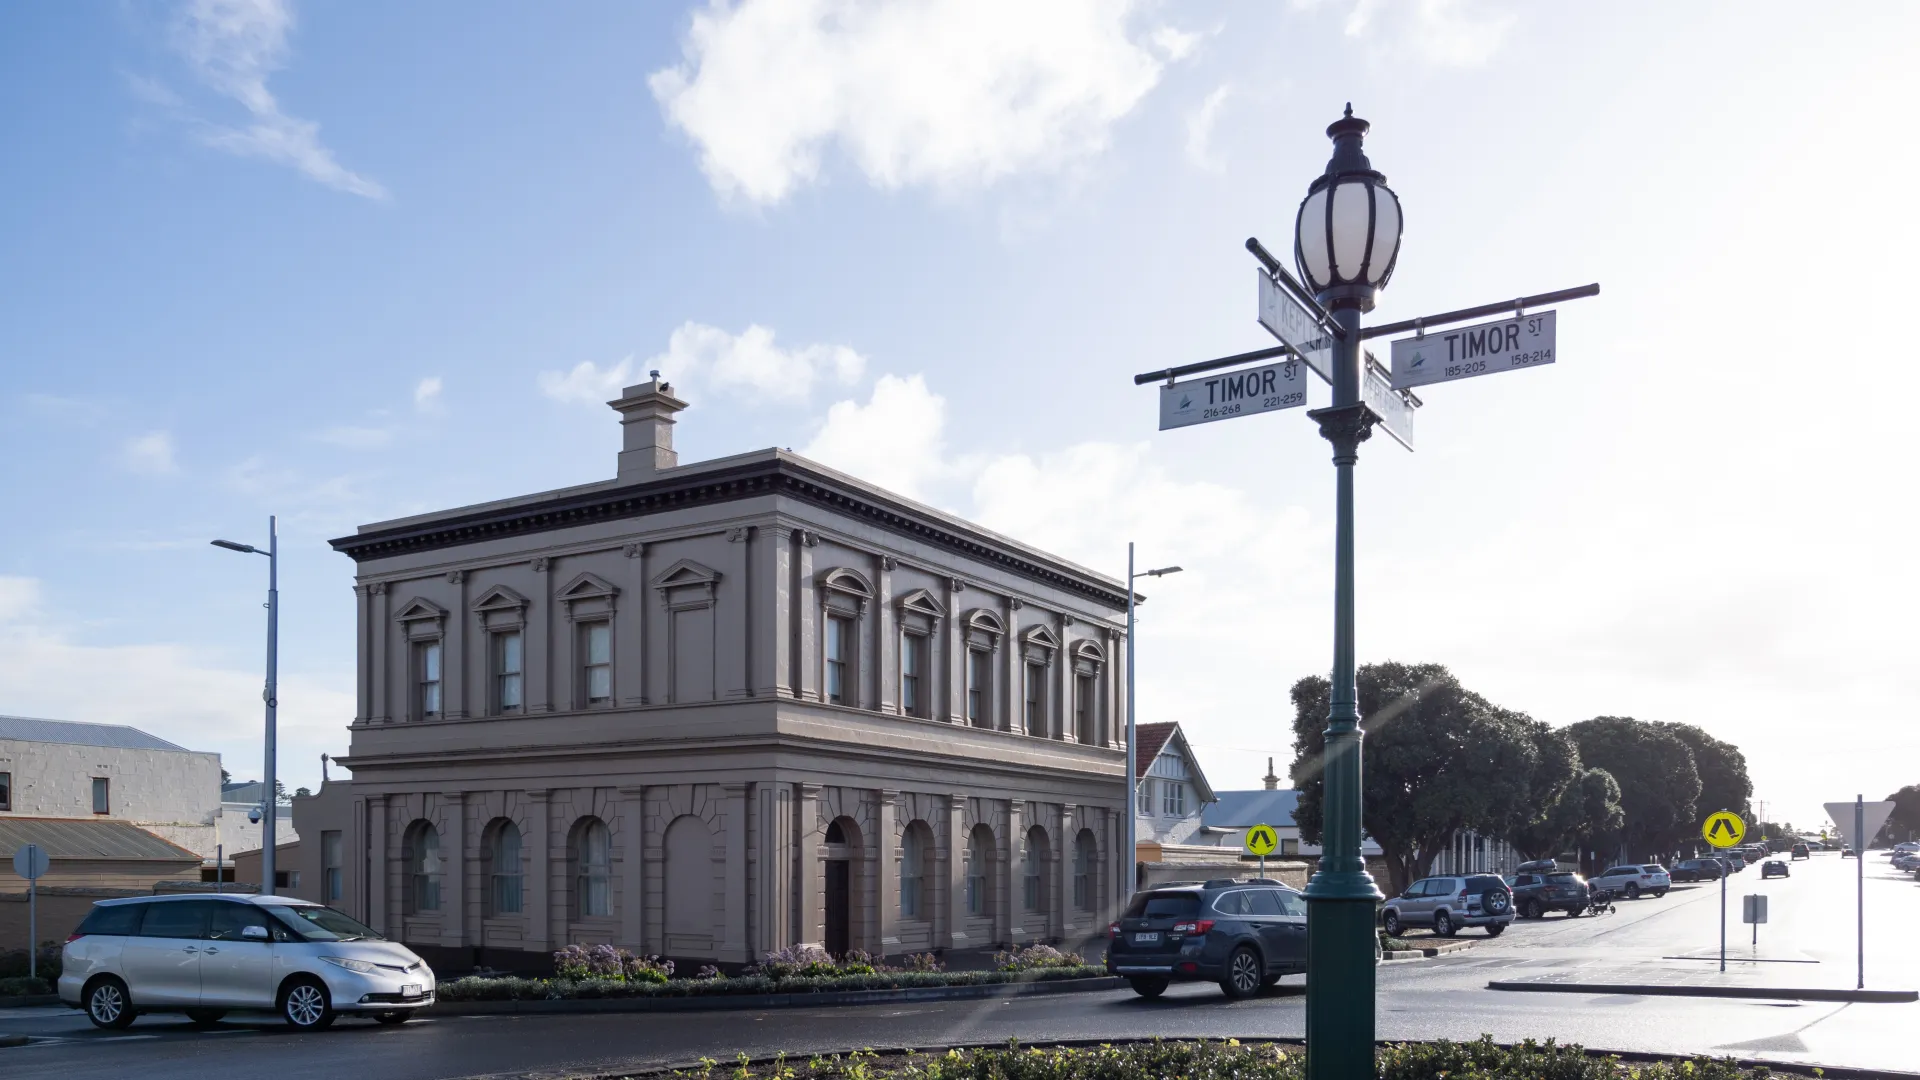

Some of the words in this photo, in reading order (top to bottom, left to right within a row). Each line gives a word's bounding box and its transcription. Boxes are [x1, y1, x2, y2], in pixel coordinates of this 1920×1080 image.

[1444, 323, 1520, 362] TIMOR
[1528, 318, 1544, 335] ST
[1444, 361, 1486, 377] 185-205
[1511, 349, 1551, 366] 158-214
[1205, 369, 1276, 405] TIMOR
[1284, 363, 1298, 379] ST
[1203, 404, 1241, 419] 216-268
[1263, 392, 1303, 408] 221-259
